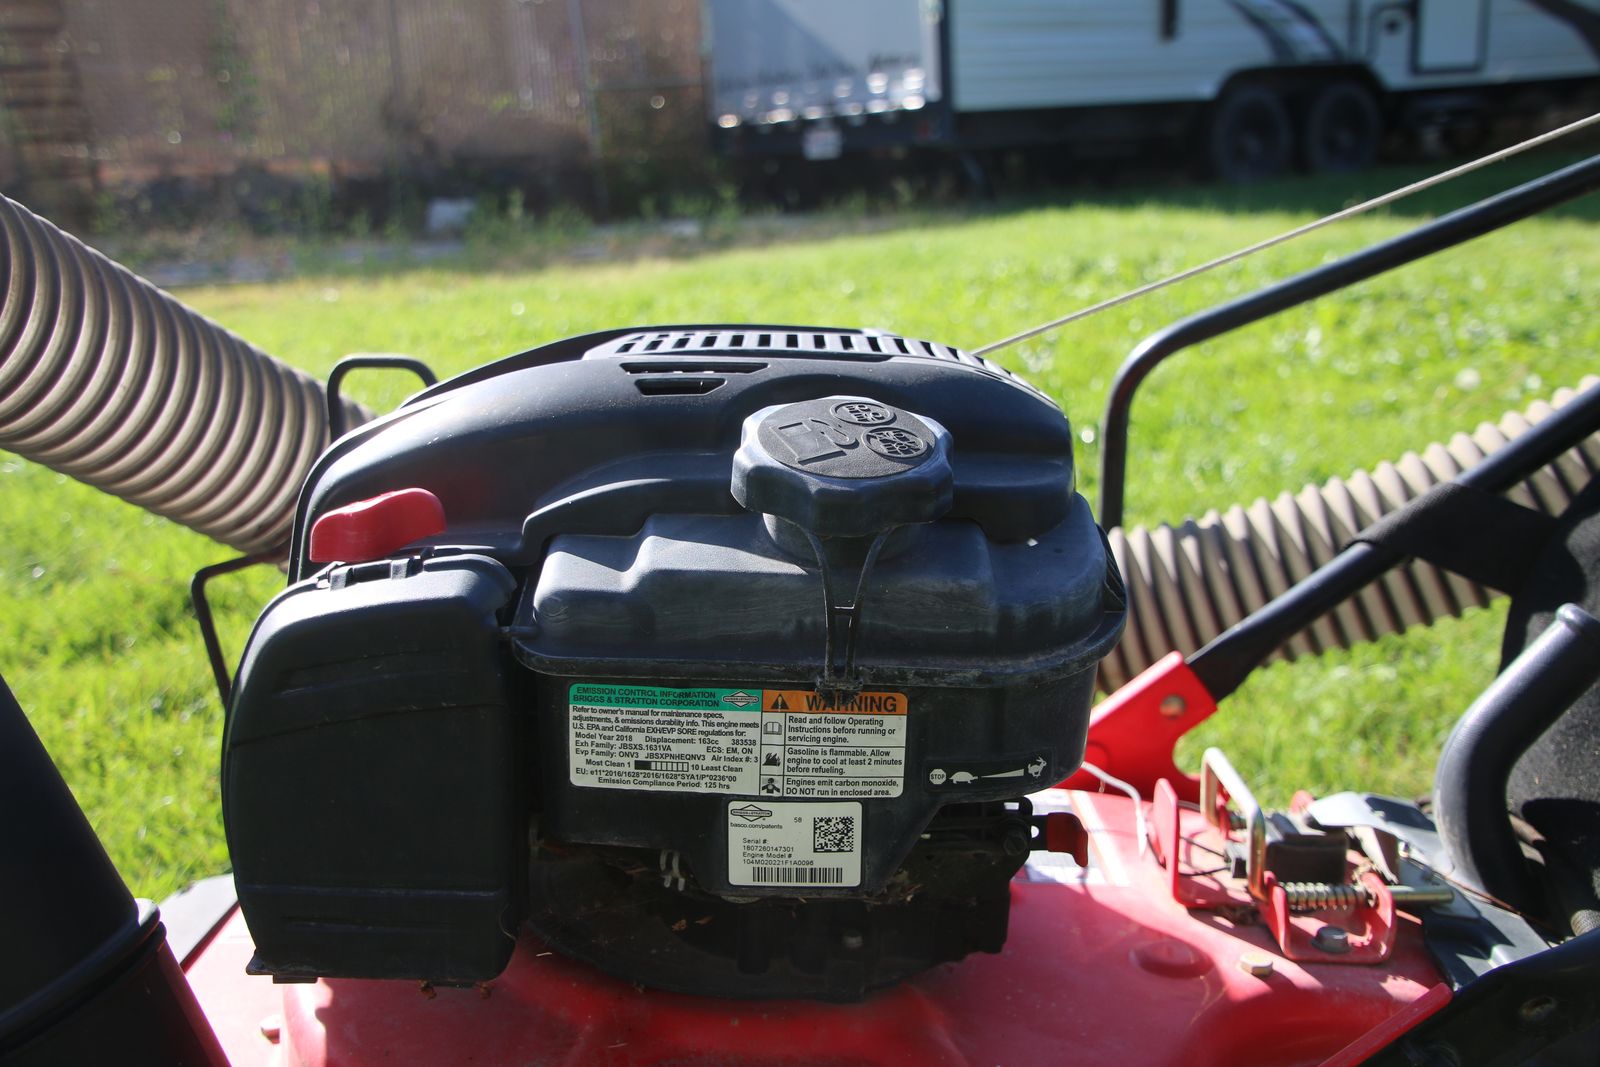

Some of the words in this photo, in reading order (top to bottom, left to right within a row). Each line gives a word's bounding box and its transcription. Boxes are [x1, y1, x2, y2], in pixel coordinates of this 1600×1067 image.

[577, 687, 616, 695] EMISSION
[660, 690, 715, 698] INFORMATION
[660, 698, 719, 707] CORPORATION
[656, 718, 684, 727] durability
[848, 717, 883, 727] Operating
[645, 736, 696, 745] Displacement:
[591, 741, 616, 750] Family:
[591, 749, 616, 758] Family:
[787, 757, 811, 766] engine
[812, 766, 845, 775] refueling.
[632, 779, 674, 787] Compliance
[786, 778, 815, 787] Engines
